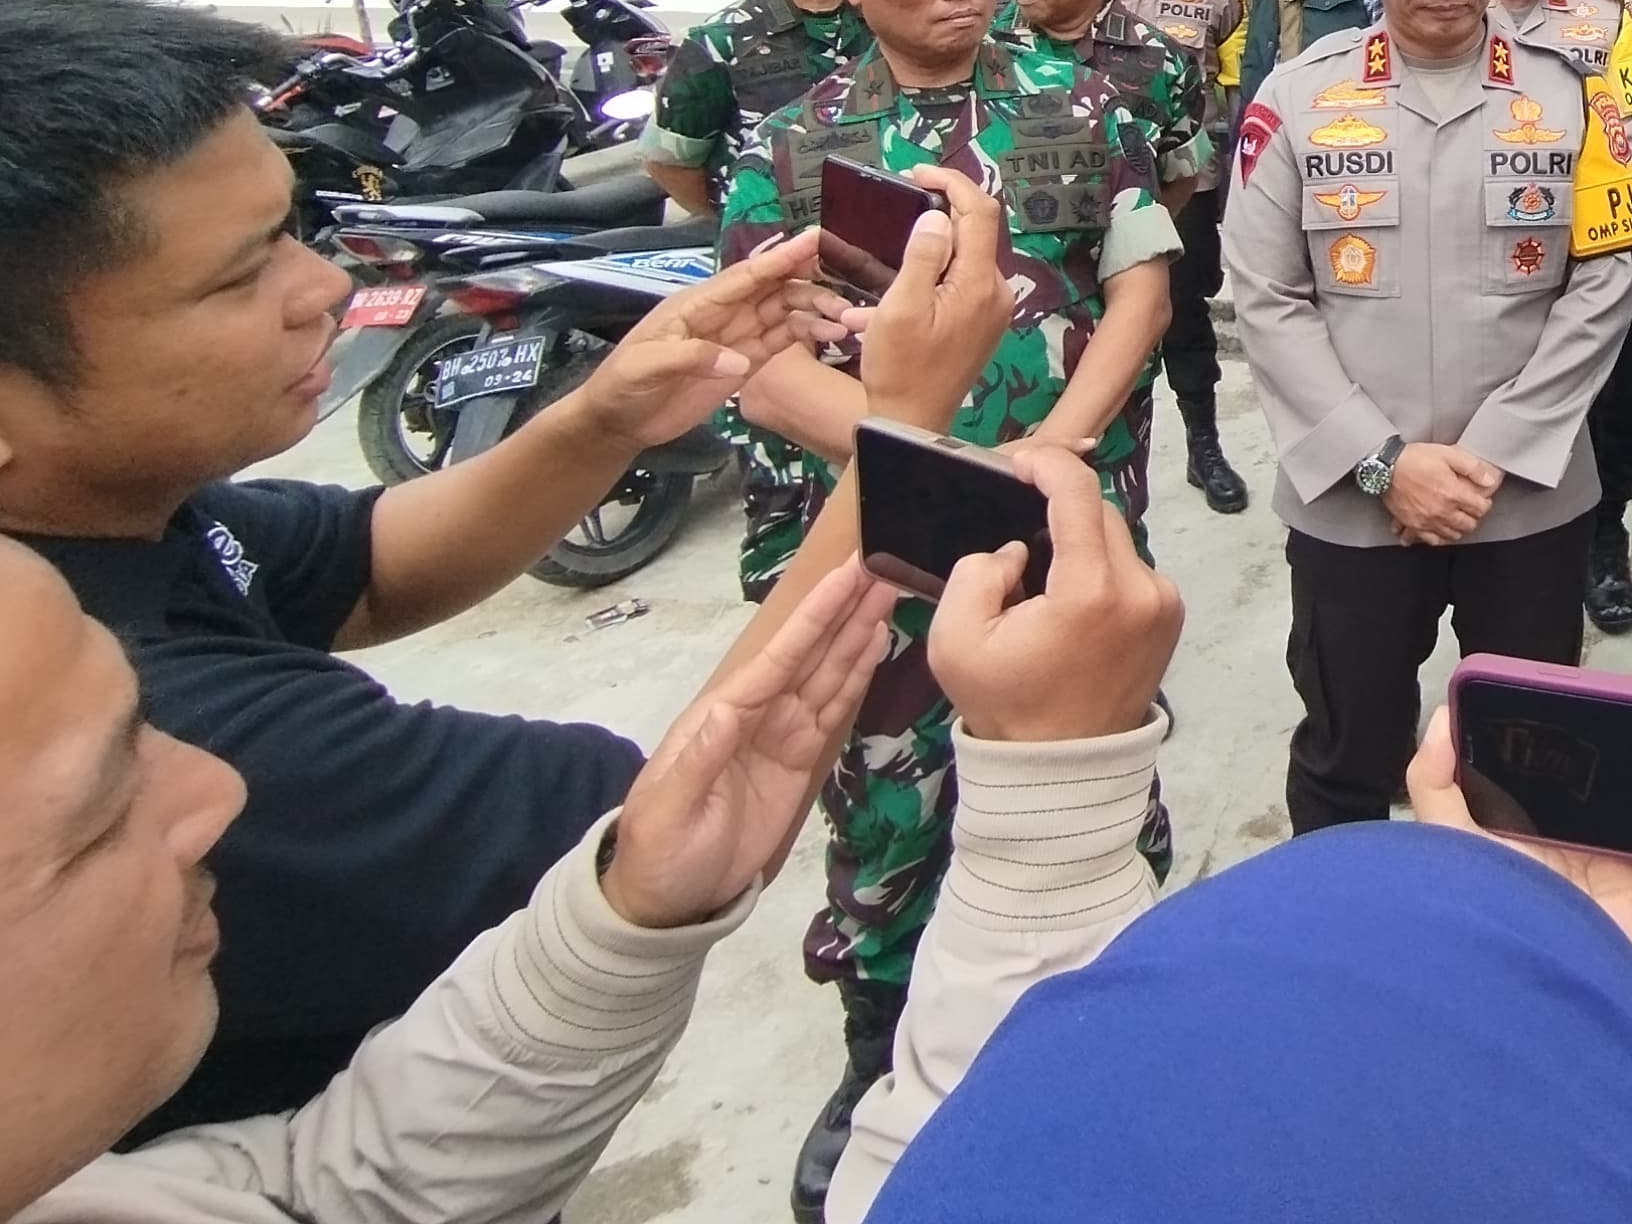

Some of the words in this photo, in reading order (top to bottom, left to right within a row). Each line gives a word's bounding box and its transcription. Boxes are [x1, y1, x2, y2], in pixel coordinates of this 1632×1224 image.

[1159, 2, 1210, 22] POLRI
[1005, 151, 1060, 173] TNI
[1070, 151, 1106, 169] AD
[1306, 150, 1394, 178] RUSDI
[1490, 150, 1573, 176] POLRI
[1587, 221, 1619, 242] OMP
[441, 356, 462, 381] BH
[514, 342, 541, 364] HX
